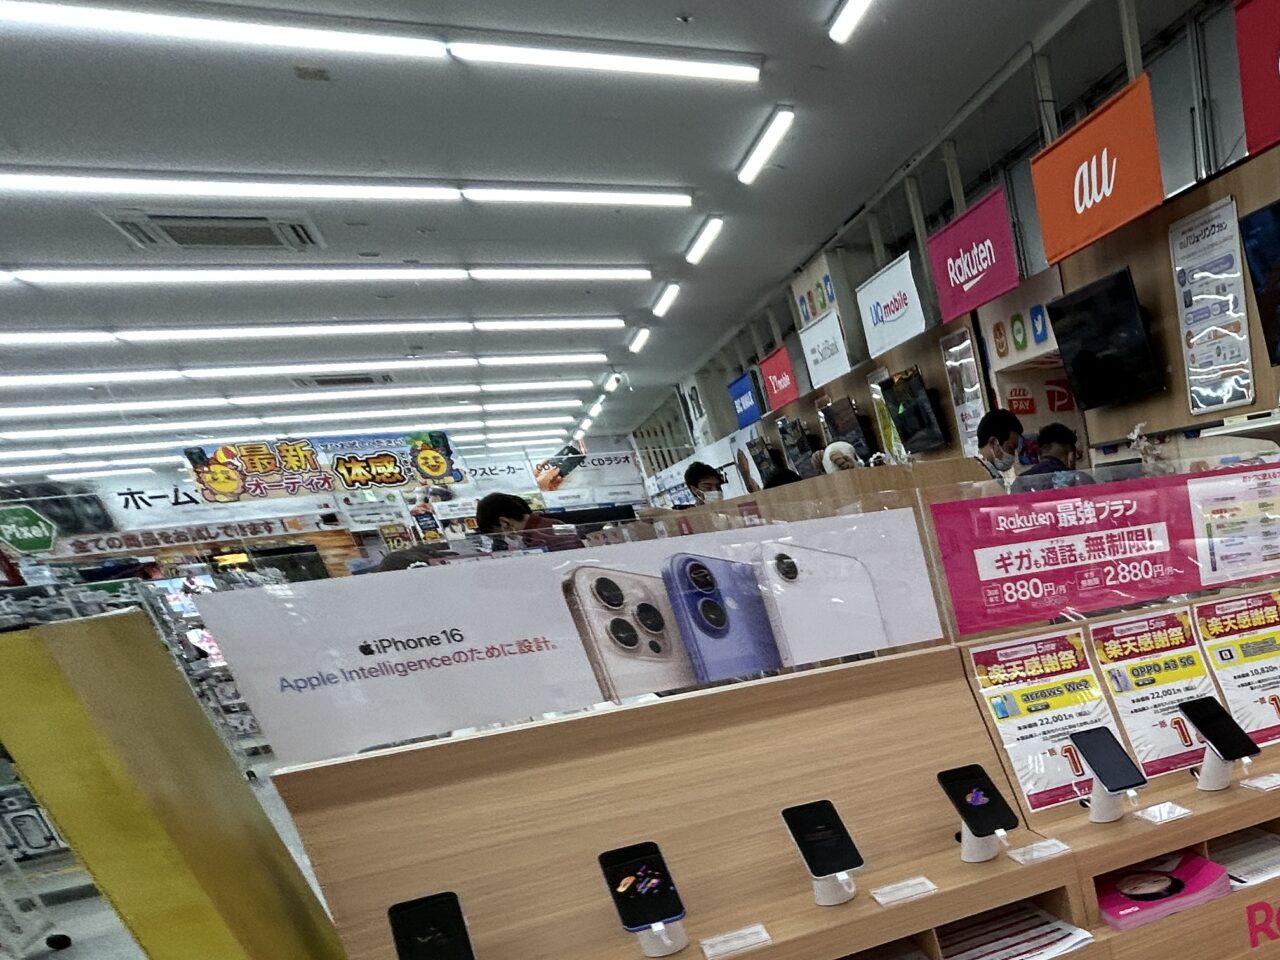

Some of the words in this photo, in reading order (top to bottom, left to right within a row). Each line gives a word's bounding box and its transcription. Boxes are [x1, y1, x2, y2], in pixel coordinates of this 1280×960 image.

[1073, 147, 1117, 215] au
[947, 238, 996, 292] Rakuten
[882, 290, 909, 320] mobile
[1011, 399, 1031, 412] PAY
[235, 439, 319, 476] 最新
[333, 451, 408, 490] 体感
[246, 472, 335, 496] オーディオ
[0, 521, 50, 540] Pixel
[996, 511, 1056, 534] Rakuten
[1056, 500, 1138, 528] 最強プラン
[1206, 605, 1280, 636] 楽天感謝祭
[374, 635, 443, 655] iPhone
[443, 628, 465, 644] 16
[1103, 626, 1187, 659] 楽天感謝祭
[279, 670, 340, 693] Apple
[986, 649, 1079, 686] 楽天感謝祭
[1130, 662, 1163, 679] OPPO
[1163, 659, 1179, 671] A3
[1021, 686, 1065, 703] arrows
[1170, 716, 1194, 747] 1
[1060, 744, 1085, 777] 1
